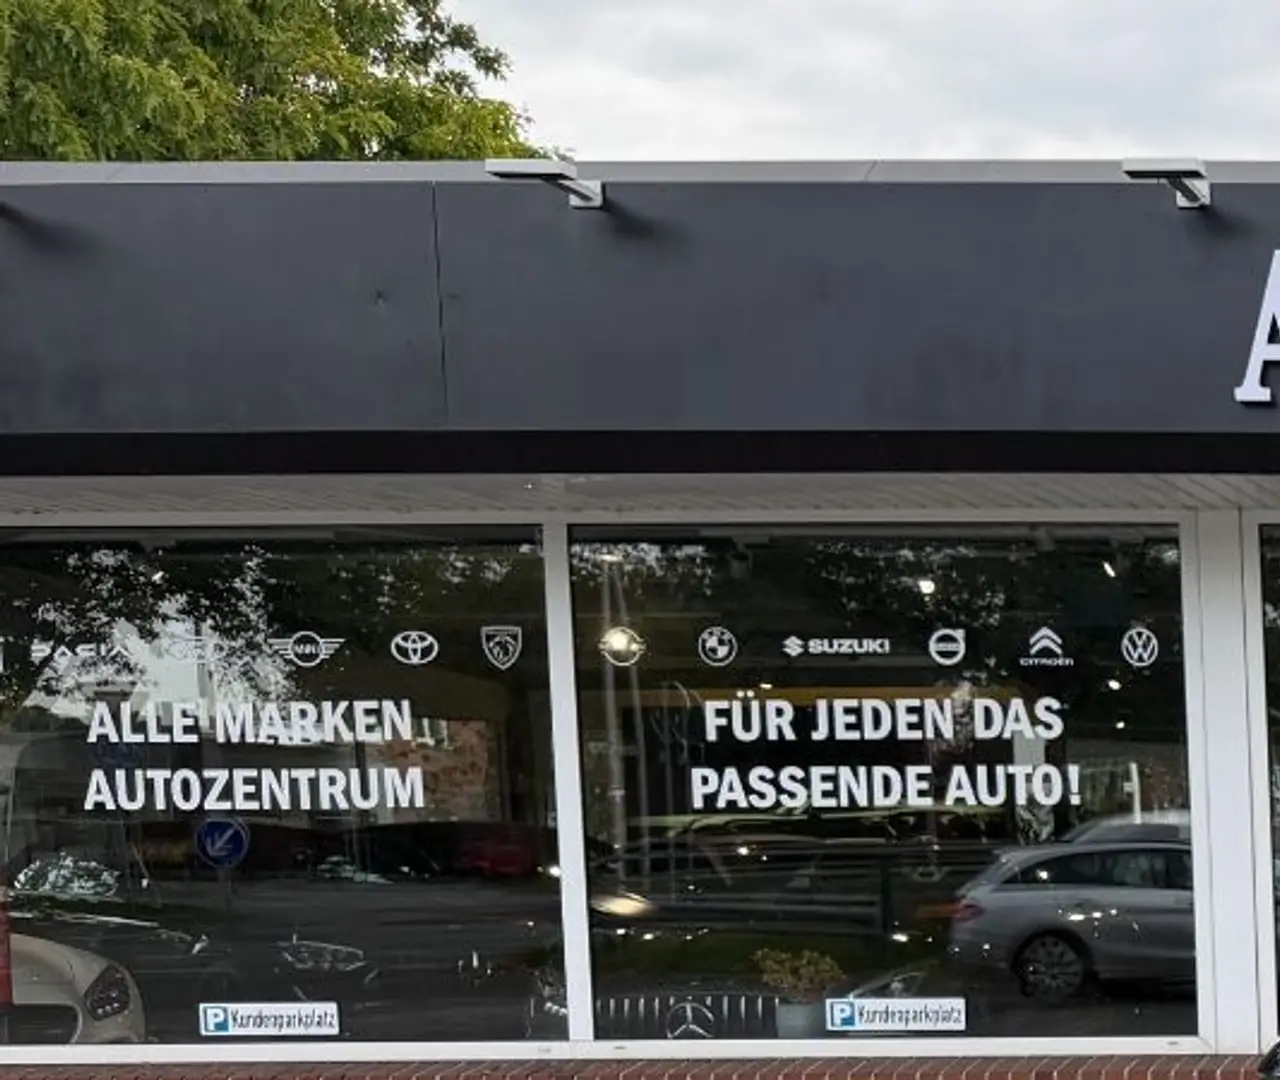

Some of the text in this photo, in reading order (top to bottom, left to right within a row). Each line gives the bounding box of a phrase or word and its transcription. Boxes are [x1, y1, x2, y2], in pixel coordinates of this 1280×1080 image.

[808, 637, 891, 655] SUZUKI
[87, 700, 413, 744] ALLE MARKEN
[705, 689, 1065, 743] FÜR JEDEN DAS
[84, 767, 425, 811] AUTOZENTRUM
[691, 764, 1082, 809] PASSENDE AUTO!
[207, 1008, 335, 1032] P Kundenparkplatz
[832, 1003, 962, 1027] P Kundenparkplatz
